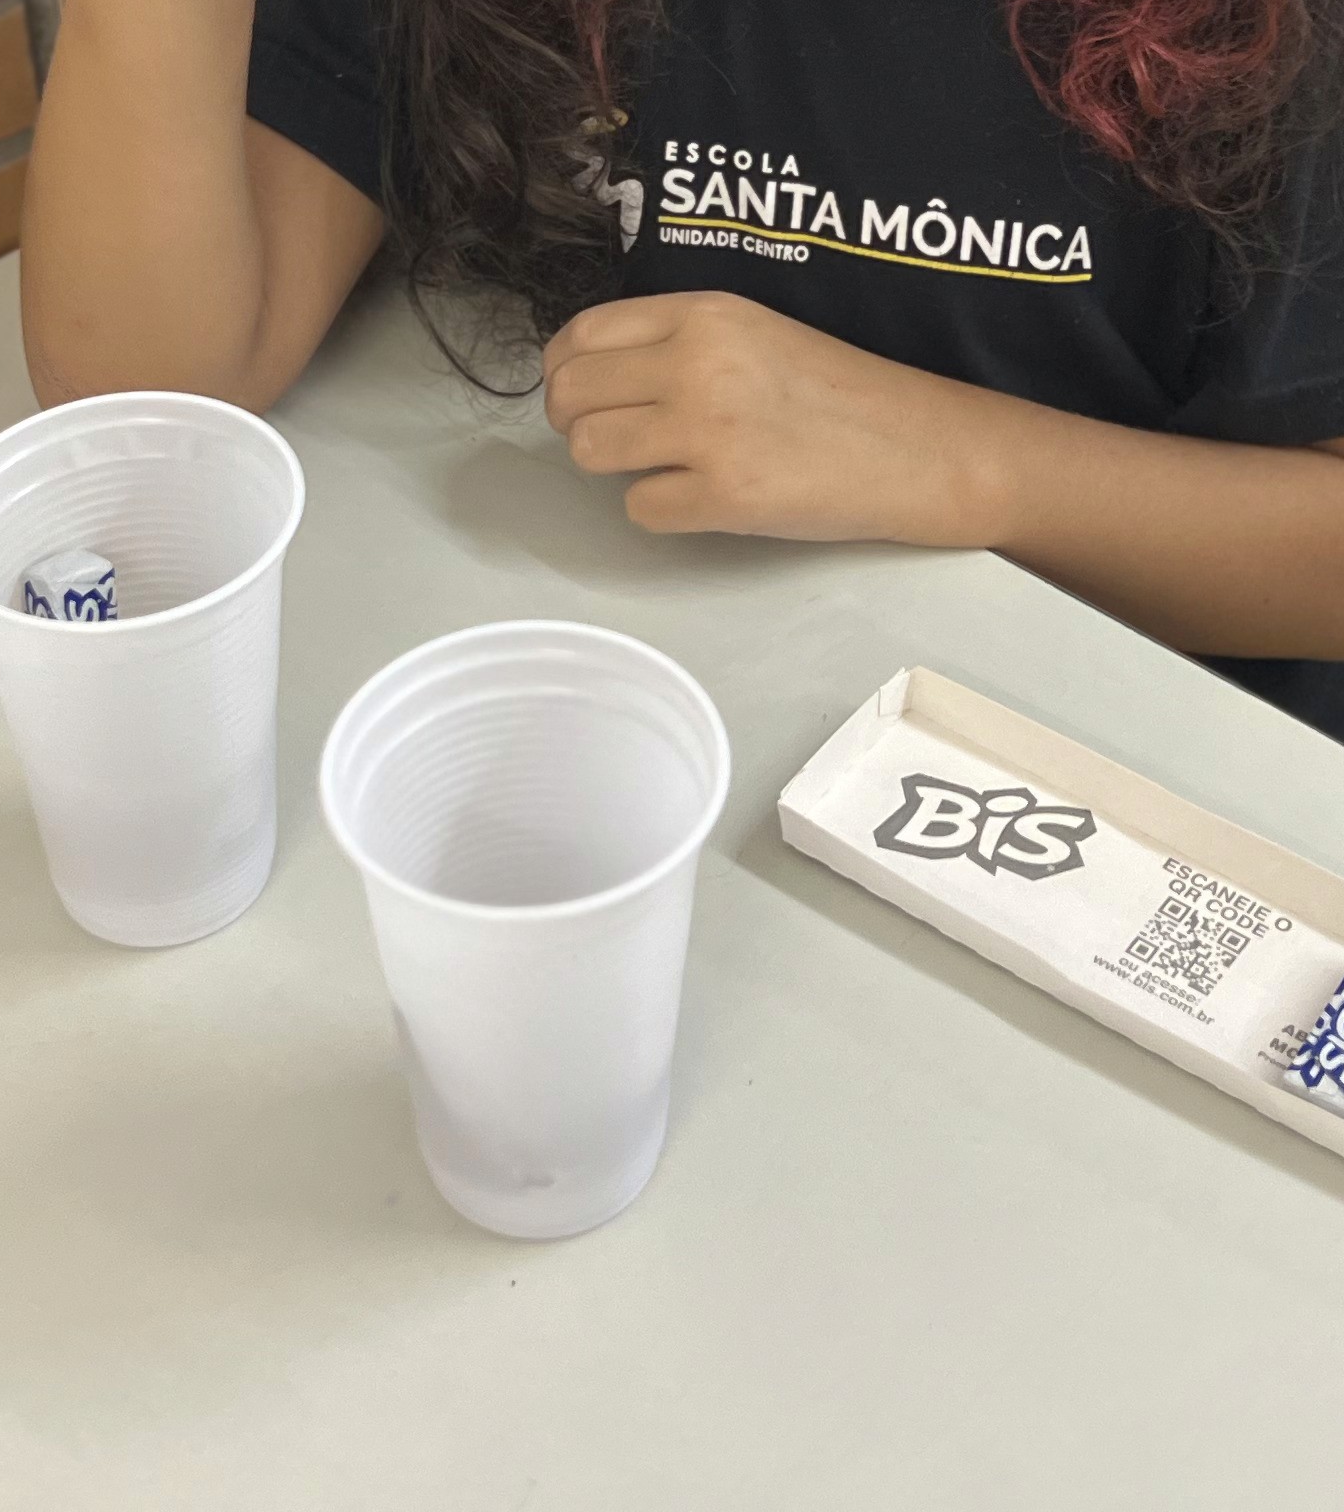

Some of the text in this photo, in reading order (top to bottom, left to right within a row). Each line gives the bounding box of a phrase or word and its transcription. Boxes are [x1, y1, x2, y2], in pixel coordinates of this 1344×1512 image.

[664, 140, 799, 177] ESCOLA
[659, 226, 810, 264] UNIDADE CENTRO
[660, 167, 1092, 272] SANTA MÔNICA
[1162, 857, 1293, 932] ESCANEIE O
[1168, 879, 1270, 939] QR CODE
[1093, 955, 1216, 1026] www.bis.com.br
[1118, 956, 1139, 973] ou
